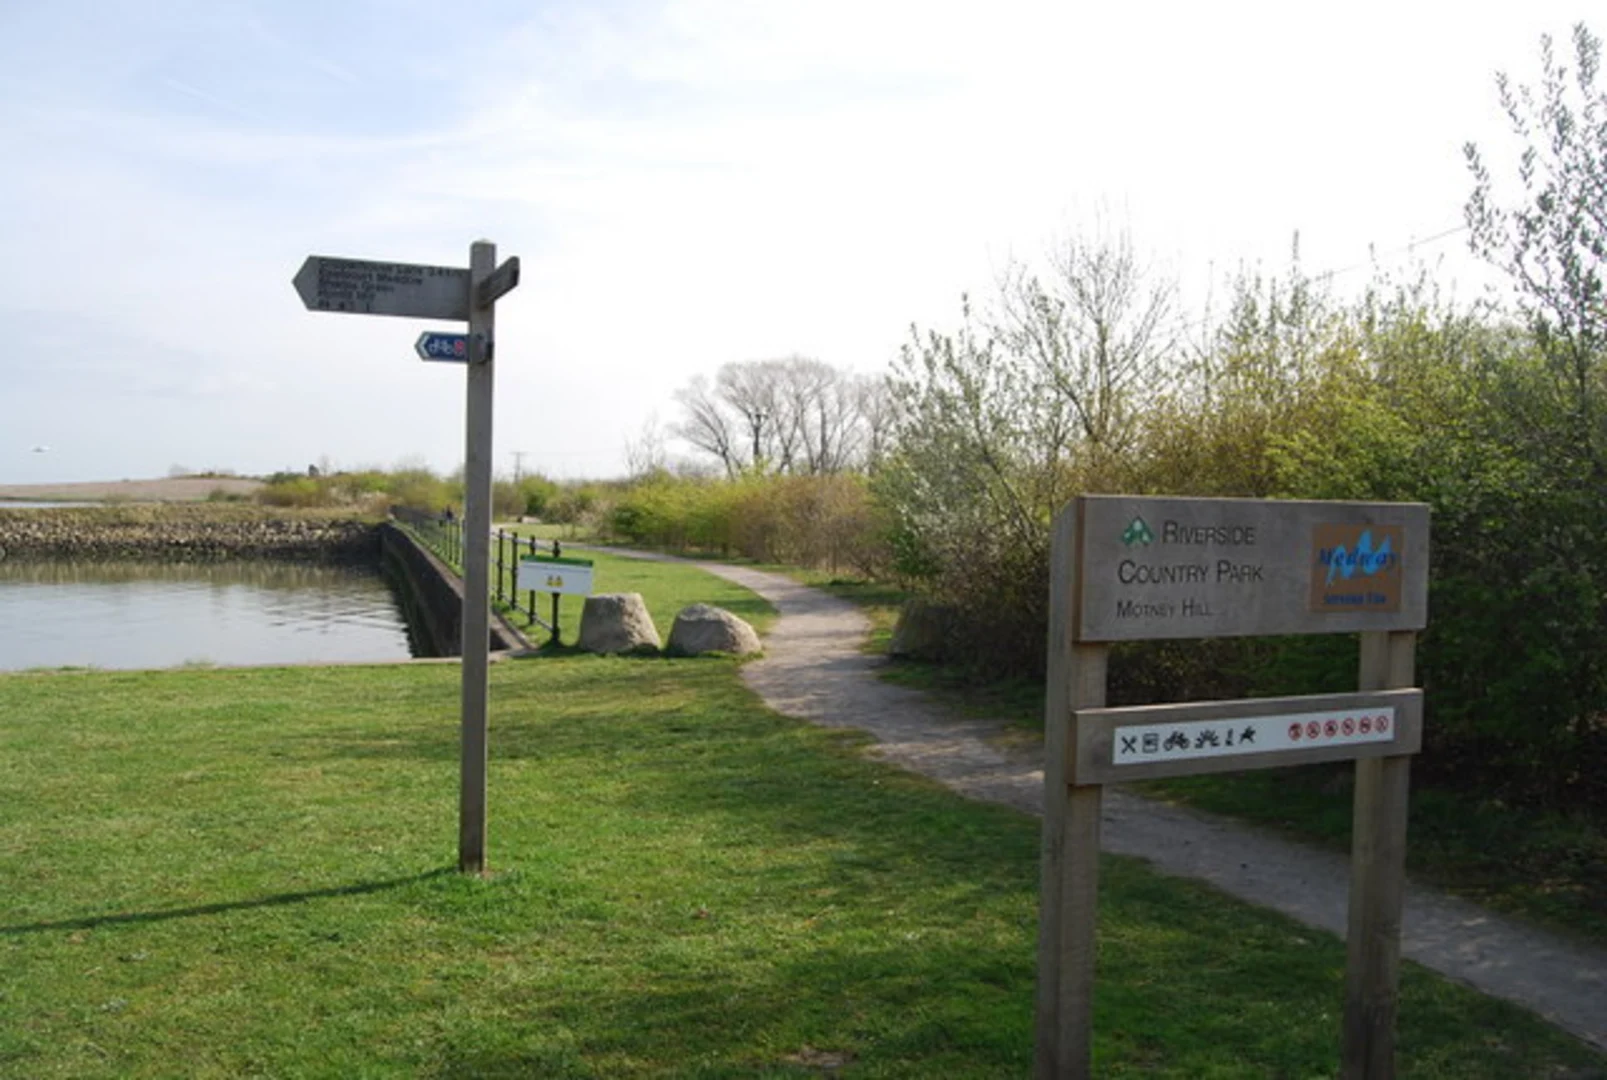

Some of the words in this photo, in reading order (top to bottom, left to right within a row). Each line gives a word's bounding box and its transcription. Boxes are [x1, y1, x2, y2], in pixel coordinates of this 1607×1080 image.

[1161, 520, 1256, 546] RIVERSIDE
[1116, 559, 1209, 586] COUNTRY
[1215, 560, 1264, 584] PARK
[1116, 598, 1175, 619] MOTNEY
[1181, 598, 1213, 618] HILL
